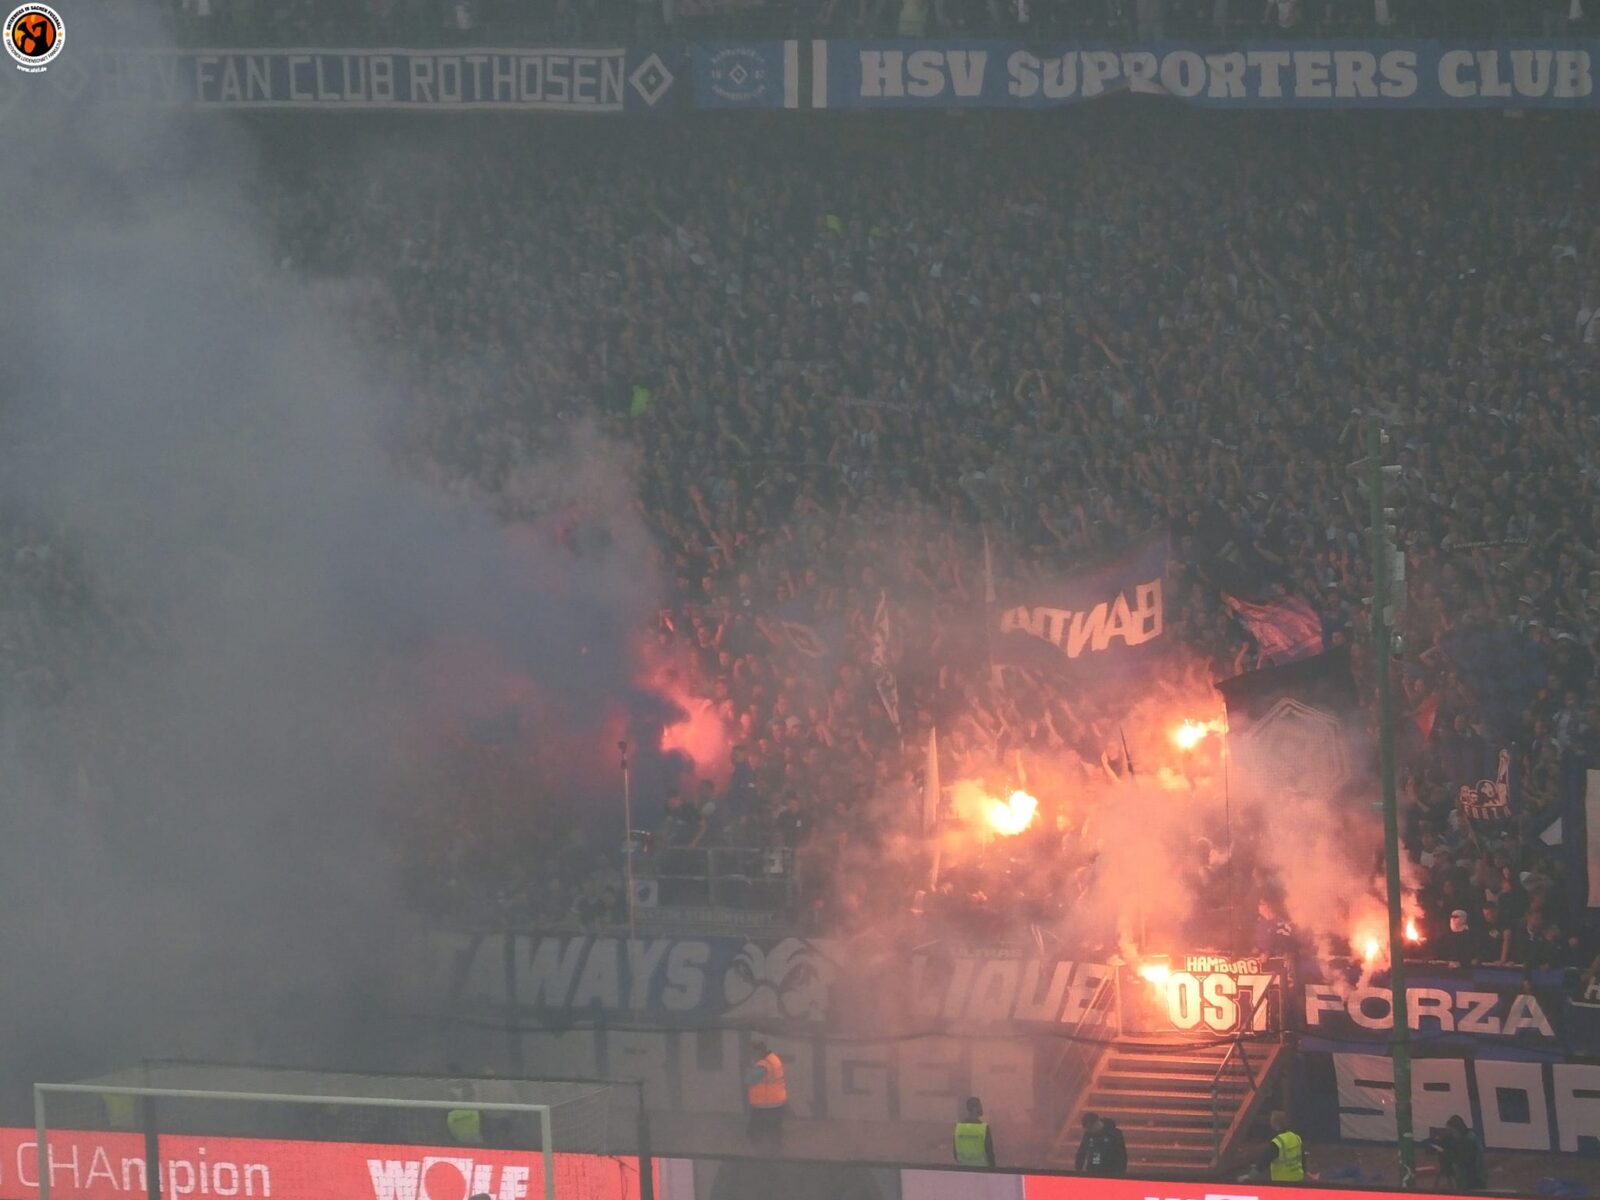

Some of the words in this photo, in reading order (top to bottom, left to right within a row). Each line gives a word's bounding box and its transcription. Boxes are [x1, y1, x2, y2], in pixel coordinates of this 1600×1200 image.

[196, 56, 271, 102] FAN
[288, 56, 394, 102] CLUB
[408, 56, 623, 103] ROTHOSEN
[859, 50, 985, 98] HSV
[1007, 50, 1419, 100] SUPPORTERS
[1438, 49, 1593, 98] CLUB
[1185, 955, 1259, 975] HAMBURG
[1305, 983, 1555, 1038] FORZA
